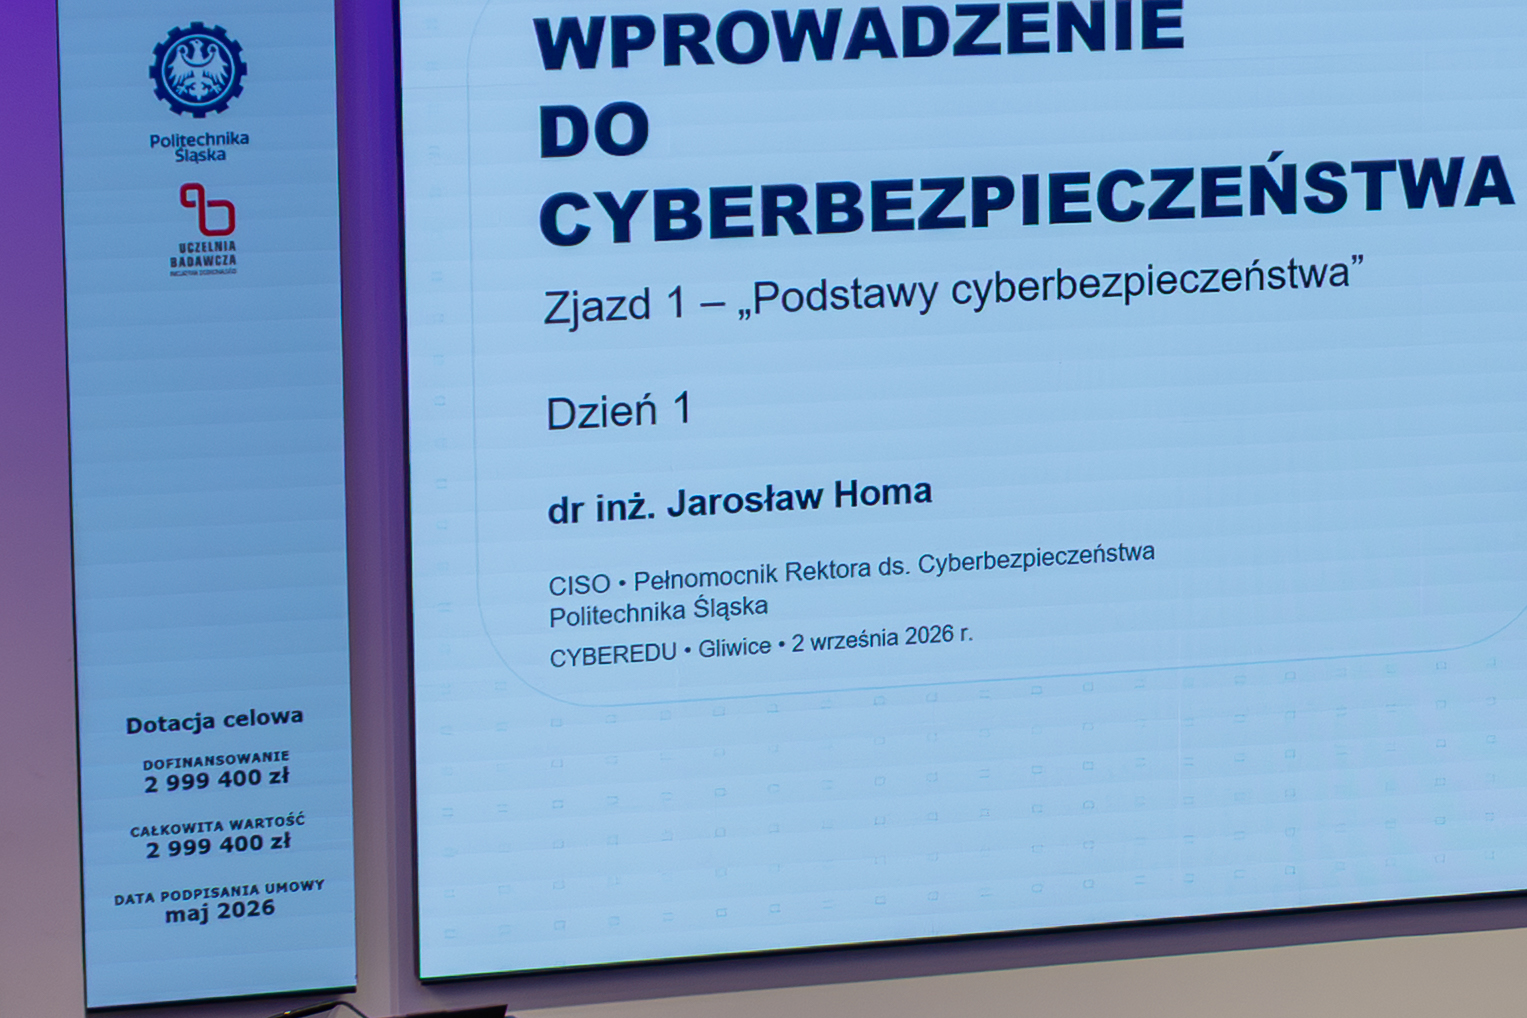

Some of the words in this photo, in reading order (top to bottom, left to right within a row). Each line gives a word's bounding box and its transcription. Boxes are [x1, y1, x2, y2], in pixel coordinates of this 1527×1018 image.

[532, 0, 1184, 71] WPROWADZENIE
[149, 131, 250, 149] Politechnika
[539, 100, 650, 159] DO
[175, 146, 227, 164] Śląska
[539, 150, 1516, 247] CYBERBEZPIECZEŃSTWA
[170, 254, 237, 268] BADAWCZA
[179, 241, 237, 254] UCZELNIA
[543, 286, 651, 333] Zjazd
[668, 285, 684, 318] 1
[738, 277, 939, 322] „Podstawy
[951, 254, 1364, 314] cyberbezpieczeństwa”
[548, 392, 657, 431] Dzień
[673, 390, 690, 424] 1
[548, 496, 585, 525] dr
[596, 491, 655, 522] inż.
[667, 484, 824, 518] Jarosław
[835, 479, 933, 509] Homa
[549, 573, 611, 596] CISO
[634, 563, 778, 592] Pełnomocnik
[786, 554, 871, 581] Rektora
[878, 556, 911, 576] ds.
[918, 542, 1155, 578] Cyberbezpieczeństwa
[550, 600, 686, 628] Politechnika
[693, 595, 769, 621] Śląska
[550, 641, 678, 668] CYBEREDU
[698, 637, 772, 658] Gliwice
[791, 634, 805, 653] 2
[810, 627, 899, 652] września
[904, 623, 955, 646] 2026
[960, 626, 973, 642] r.
[126, 711, 215, 735] Dotacja
[223, 708, 304, 728] celowa
[143, 750, 290, 771] DOFINANSOWANIE
[144, 776, 158, 793] 2
[166, 772, 210, 791] 999
[217, 769, 262, 788] 400
[269, 766, 290, 785] zł
[130, 821, 224, 838] CAŁKOWITA
[229, 811, 306, 831] WARTOŚĆ
[146, 842, 160, 859] 2
[168, 838, 211, 857] 999
[219, 834, 263, 853] 400
[270, 831, 291, 850] zł
[114, 892, 155, 906] DATA
[160, 884, 260, 903] PODPISANIA
[265, 879, 325, 894] UMOWY
[165, 903, 209, 925] maj
[217, 898, 275, 920] 2026
